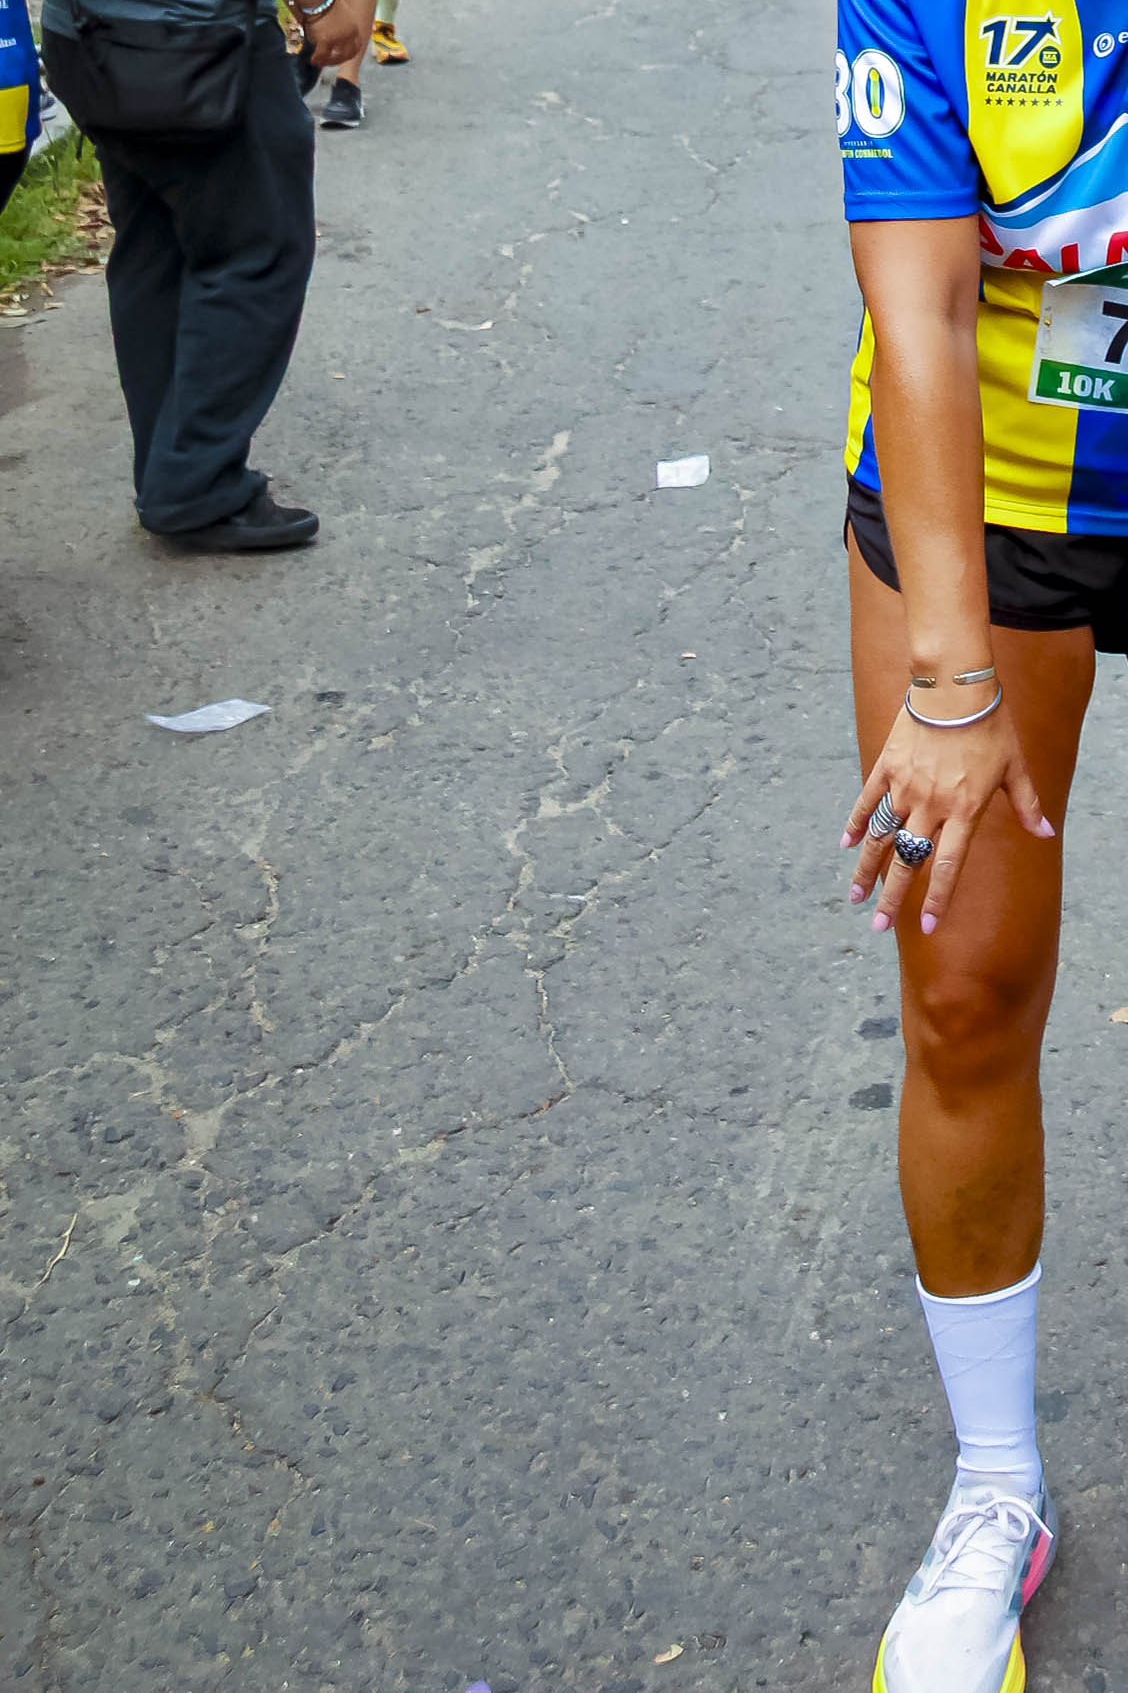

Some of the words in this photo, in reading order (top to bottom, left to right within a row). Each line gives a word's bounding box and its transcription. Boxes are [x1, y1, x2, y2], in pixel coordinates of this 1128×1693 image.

[982, 18, 1056, 66] 17
[986, 70, 1058, 84] MARATÓN
[987, 83, 1056, 94] CANALLA
[1056, 371, 1115, 402] 10K
